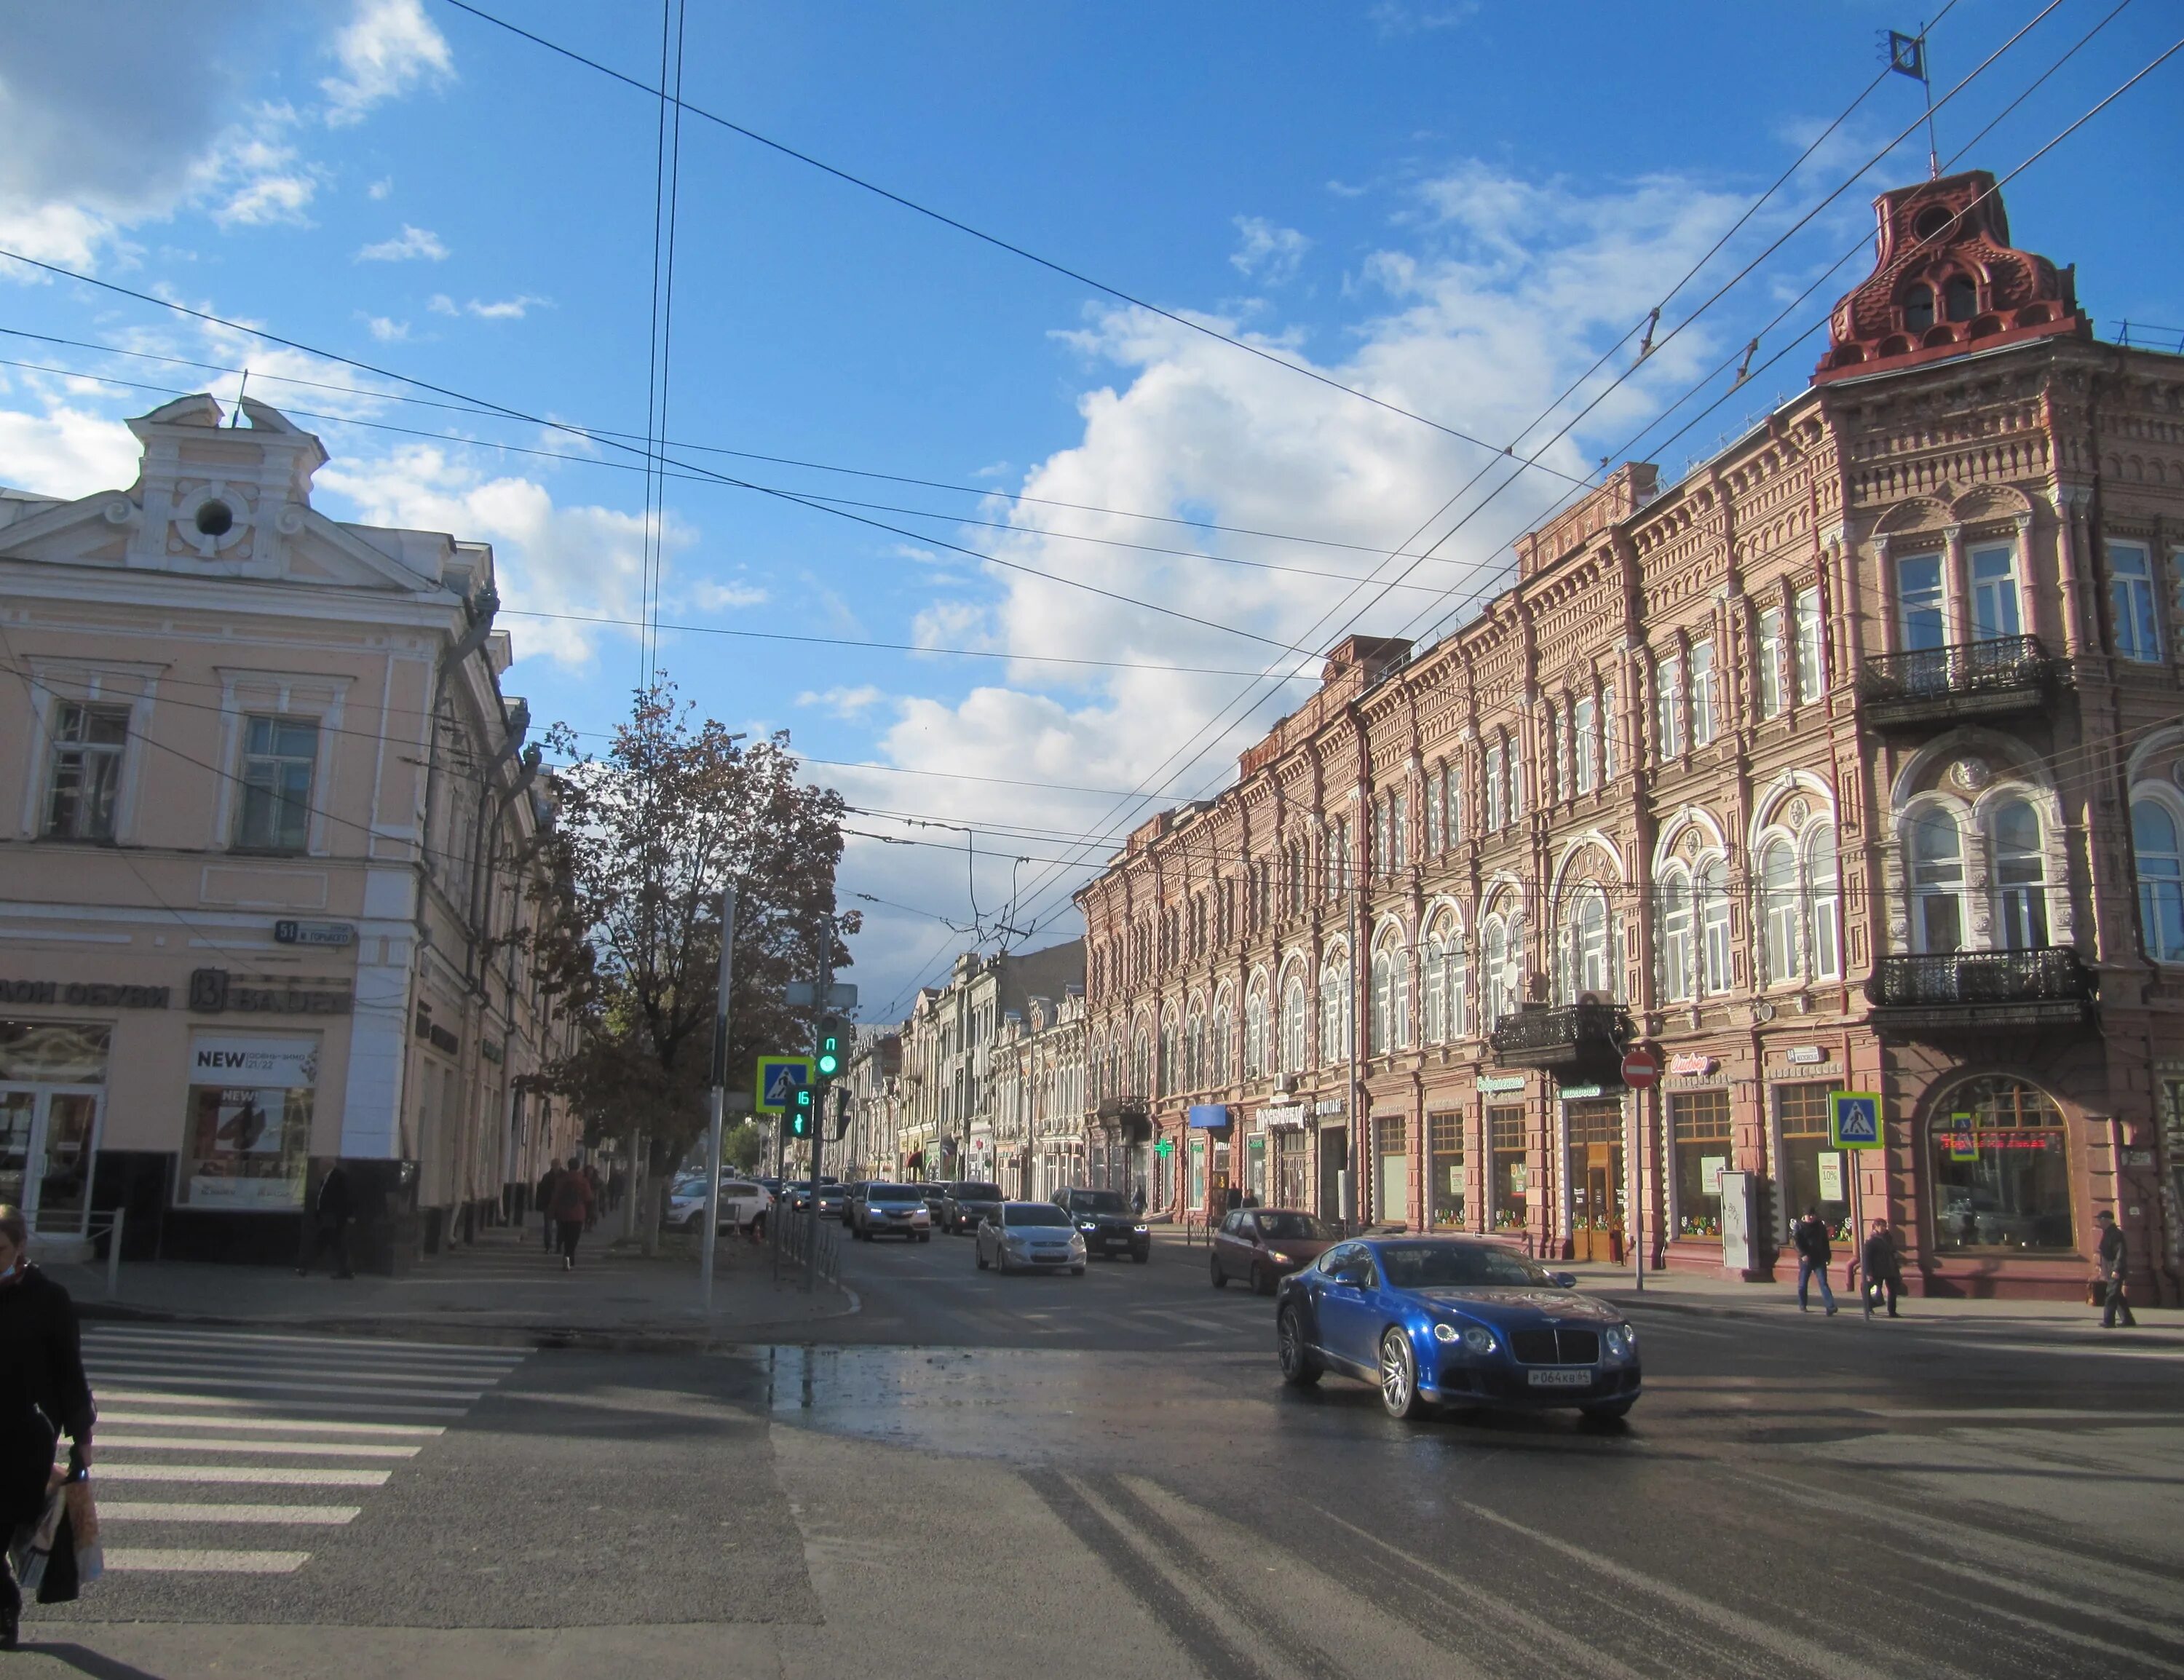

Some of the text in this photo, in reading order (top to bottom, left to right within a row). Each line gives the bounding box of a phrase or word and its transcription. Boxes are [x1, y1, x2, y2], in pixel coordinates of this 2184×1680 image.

[280, 923, 294, 938] 51
[66, 983, 170, 1009] ОБУВИ
[197, 1051, 246, 1069] NEW
[248, 1061, 273, 1070] 21/22
[798, 1091, 810, 1105] 16
[1823, 1170, 1837, 1180] 10%
